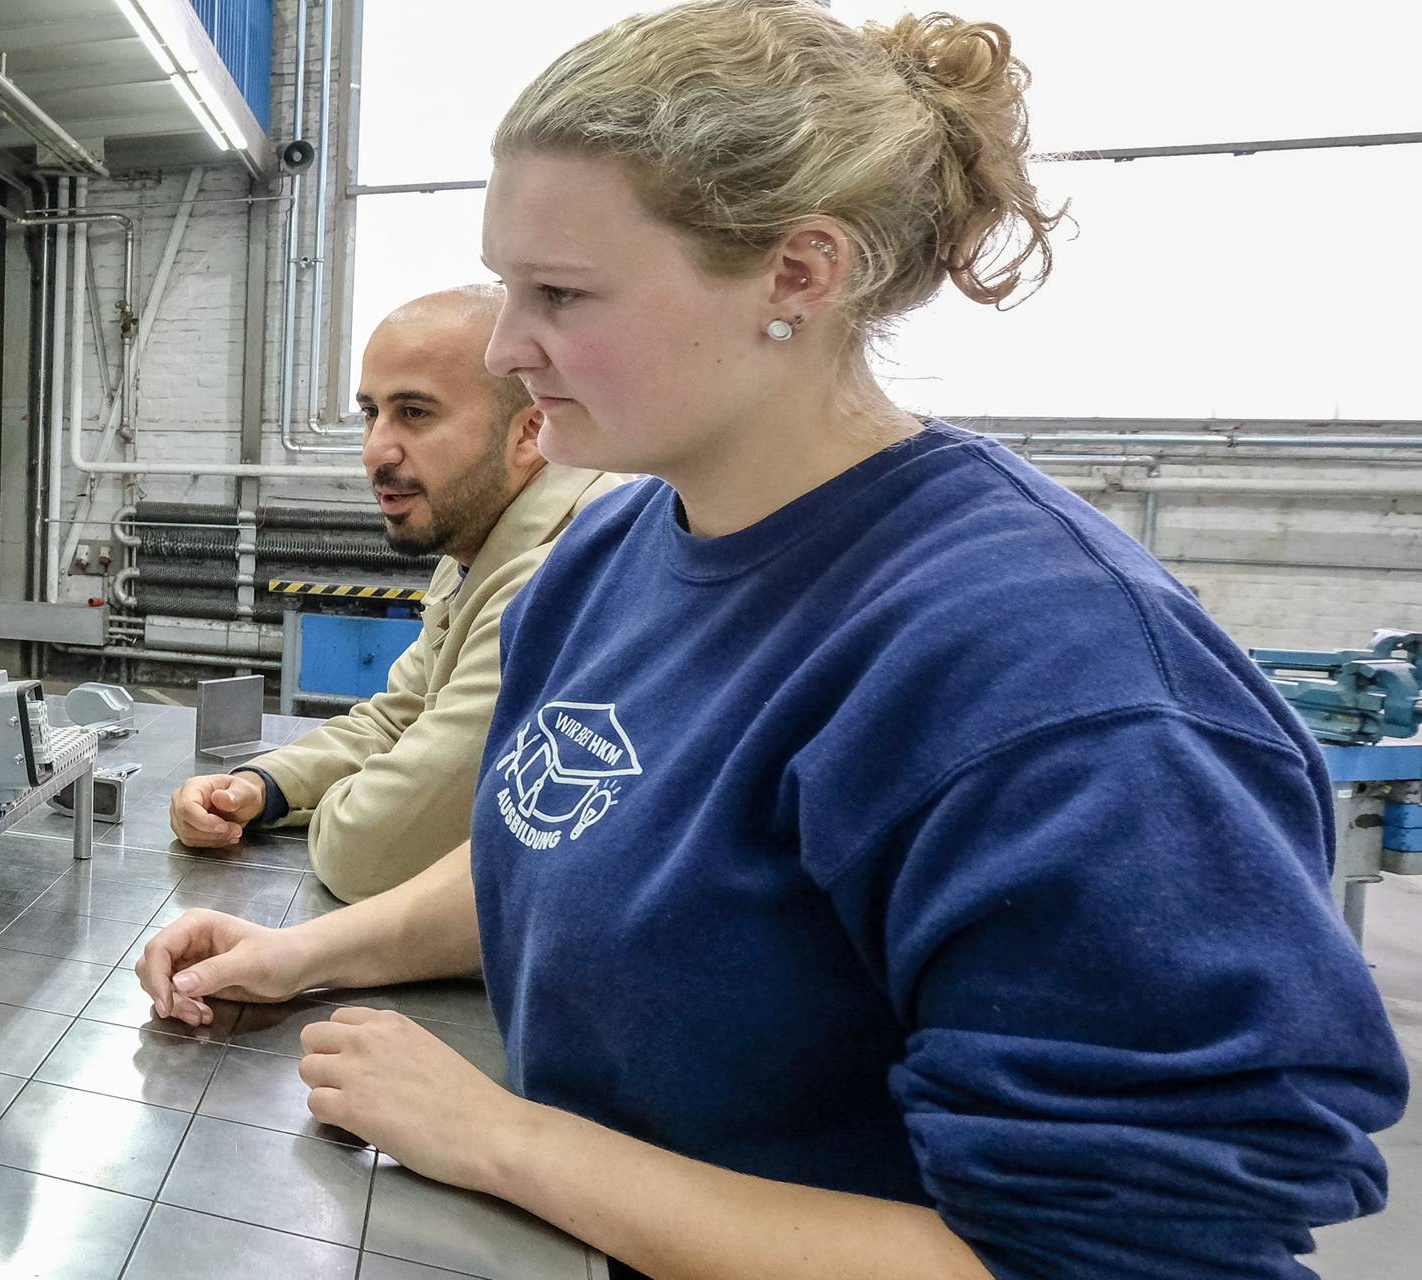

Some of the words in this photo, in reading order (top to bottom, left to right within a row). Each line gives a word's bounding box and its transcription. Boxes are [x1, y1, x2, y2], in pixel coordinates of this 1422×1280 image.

[555, 711, 582, 739] WIR
[573, 726, 594, 747] BEI
[587, 734, 624, 766] HKM
[497, 788, 563, 850] AUSBILDUNG
